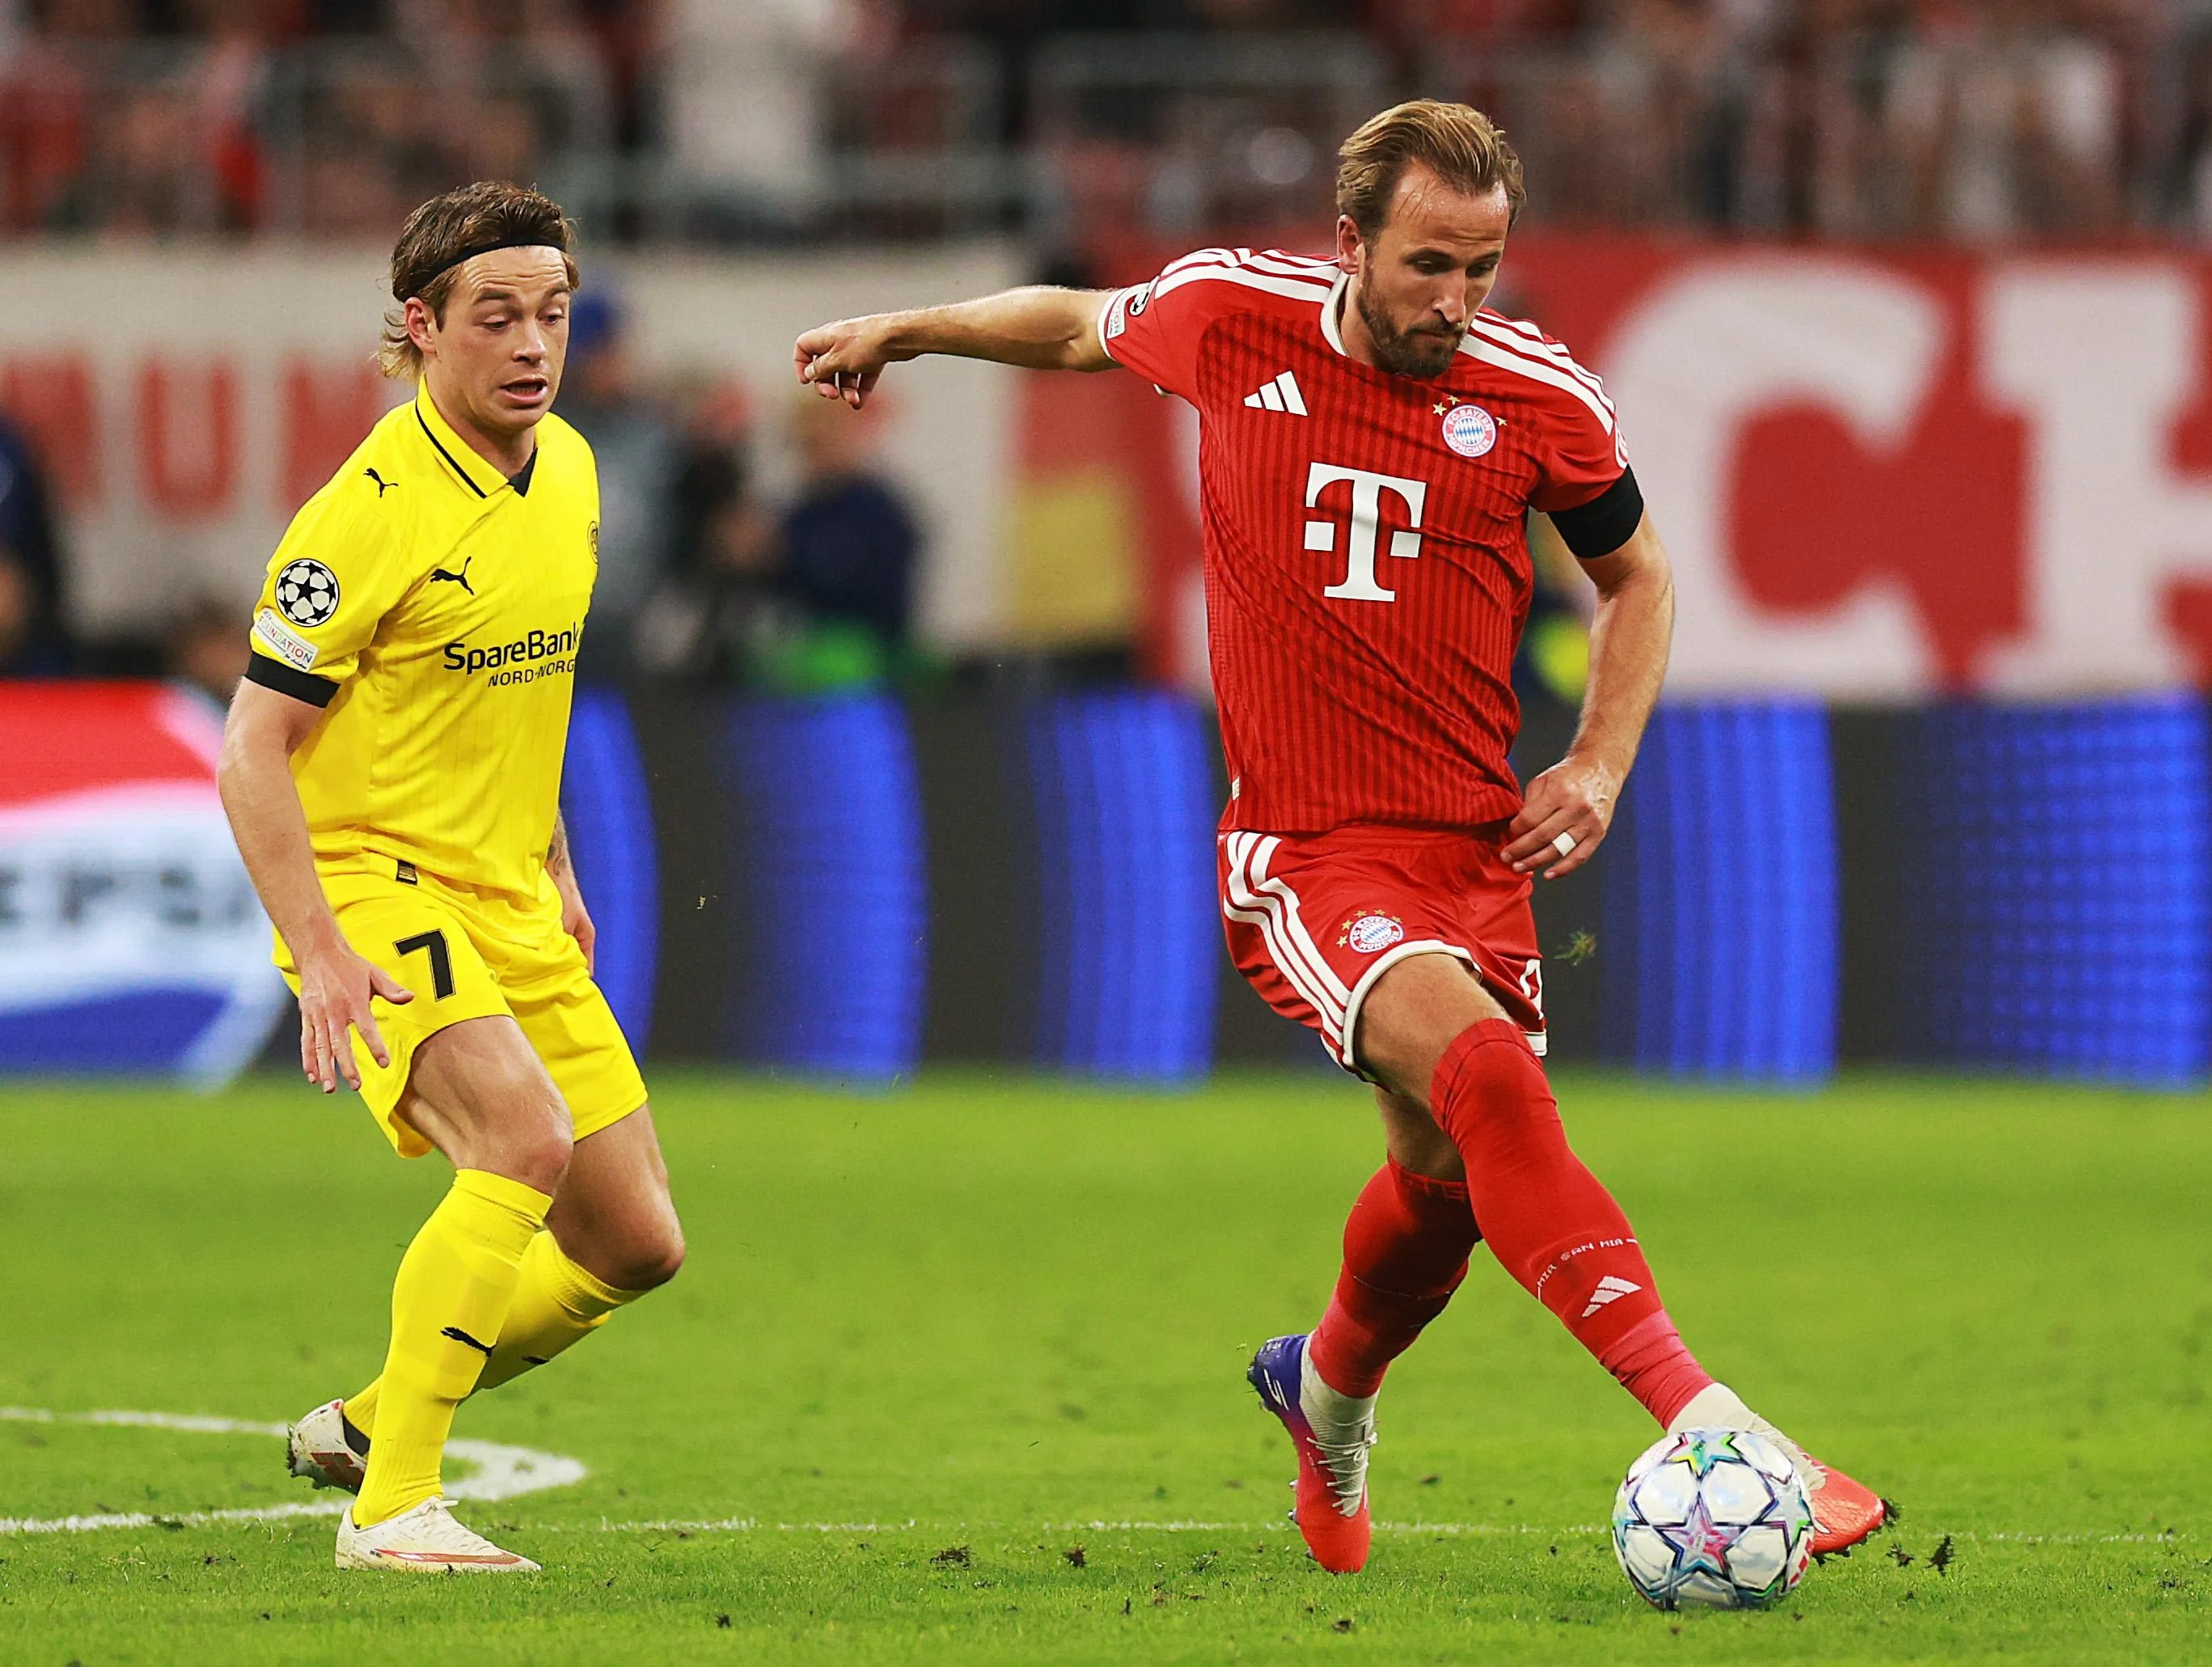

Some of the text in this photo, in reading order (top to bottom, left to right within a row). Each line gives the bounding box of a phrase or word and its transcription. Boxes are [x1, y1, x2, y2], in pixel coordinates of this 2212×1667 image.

[1305, 462, 1427, 603] T
[443, 621, 582, 675] SpareBank
[393, 928, 456, 1002] 7
[1537, 1263, 1557, 1288] MIA
[1600, 1238, 1624, 1248] MIA
